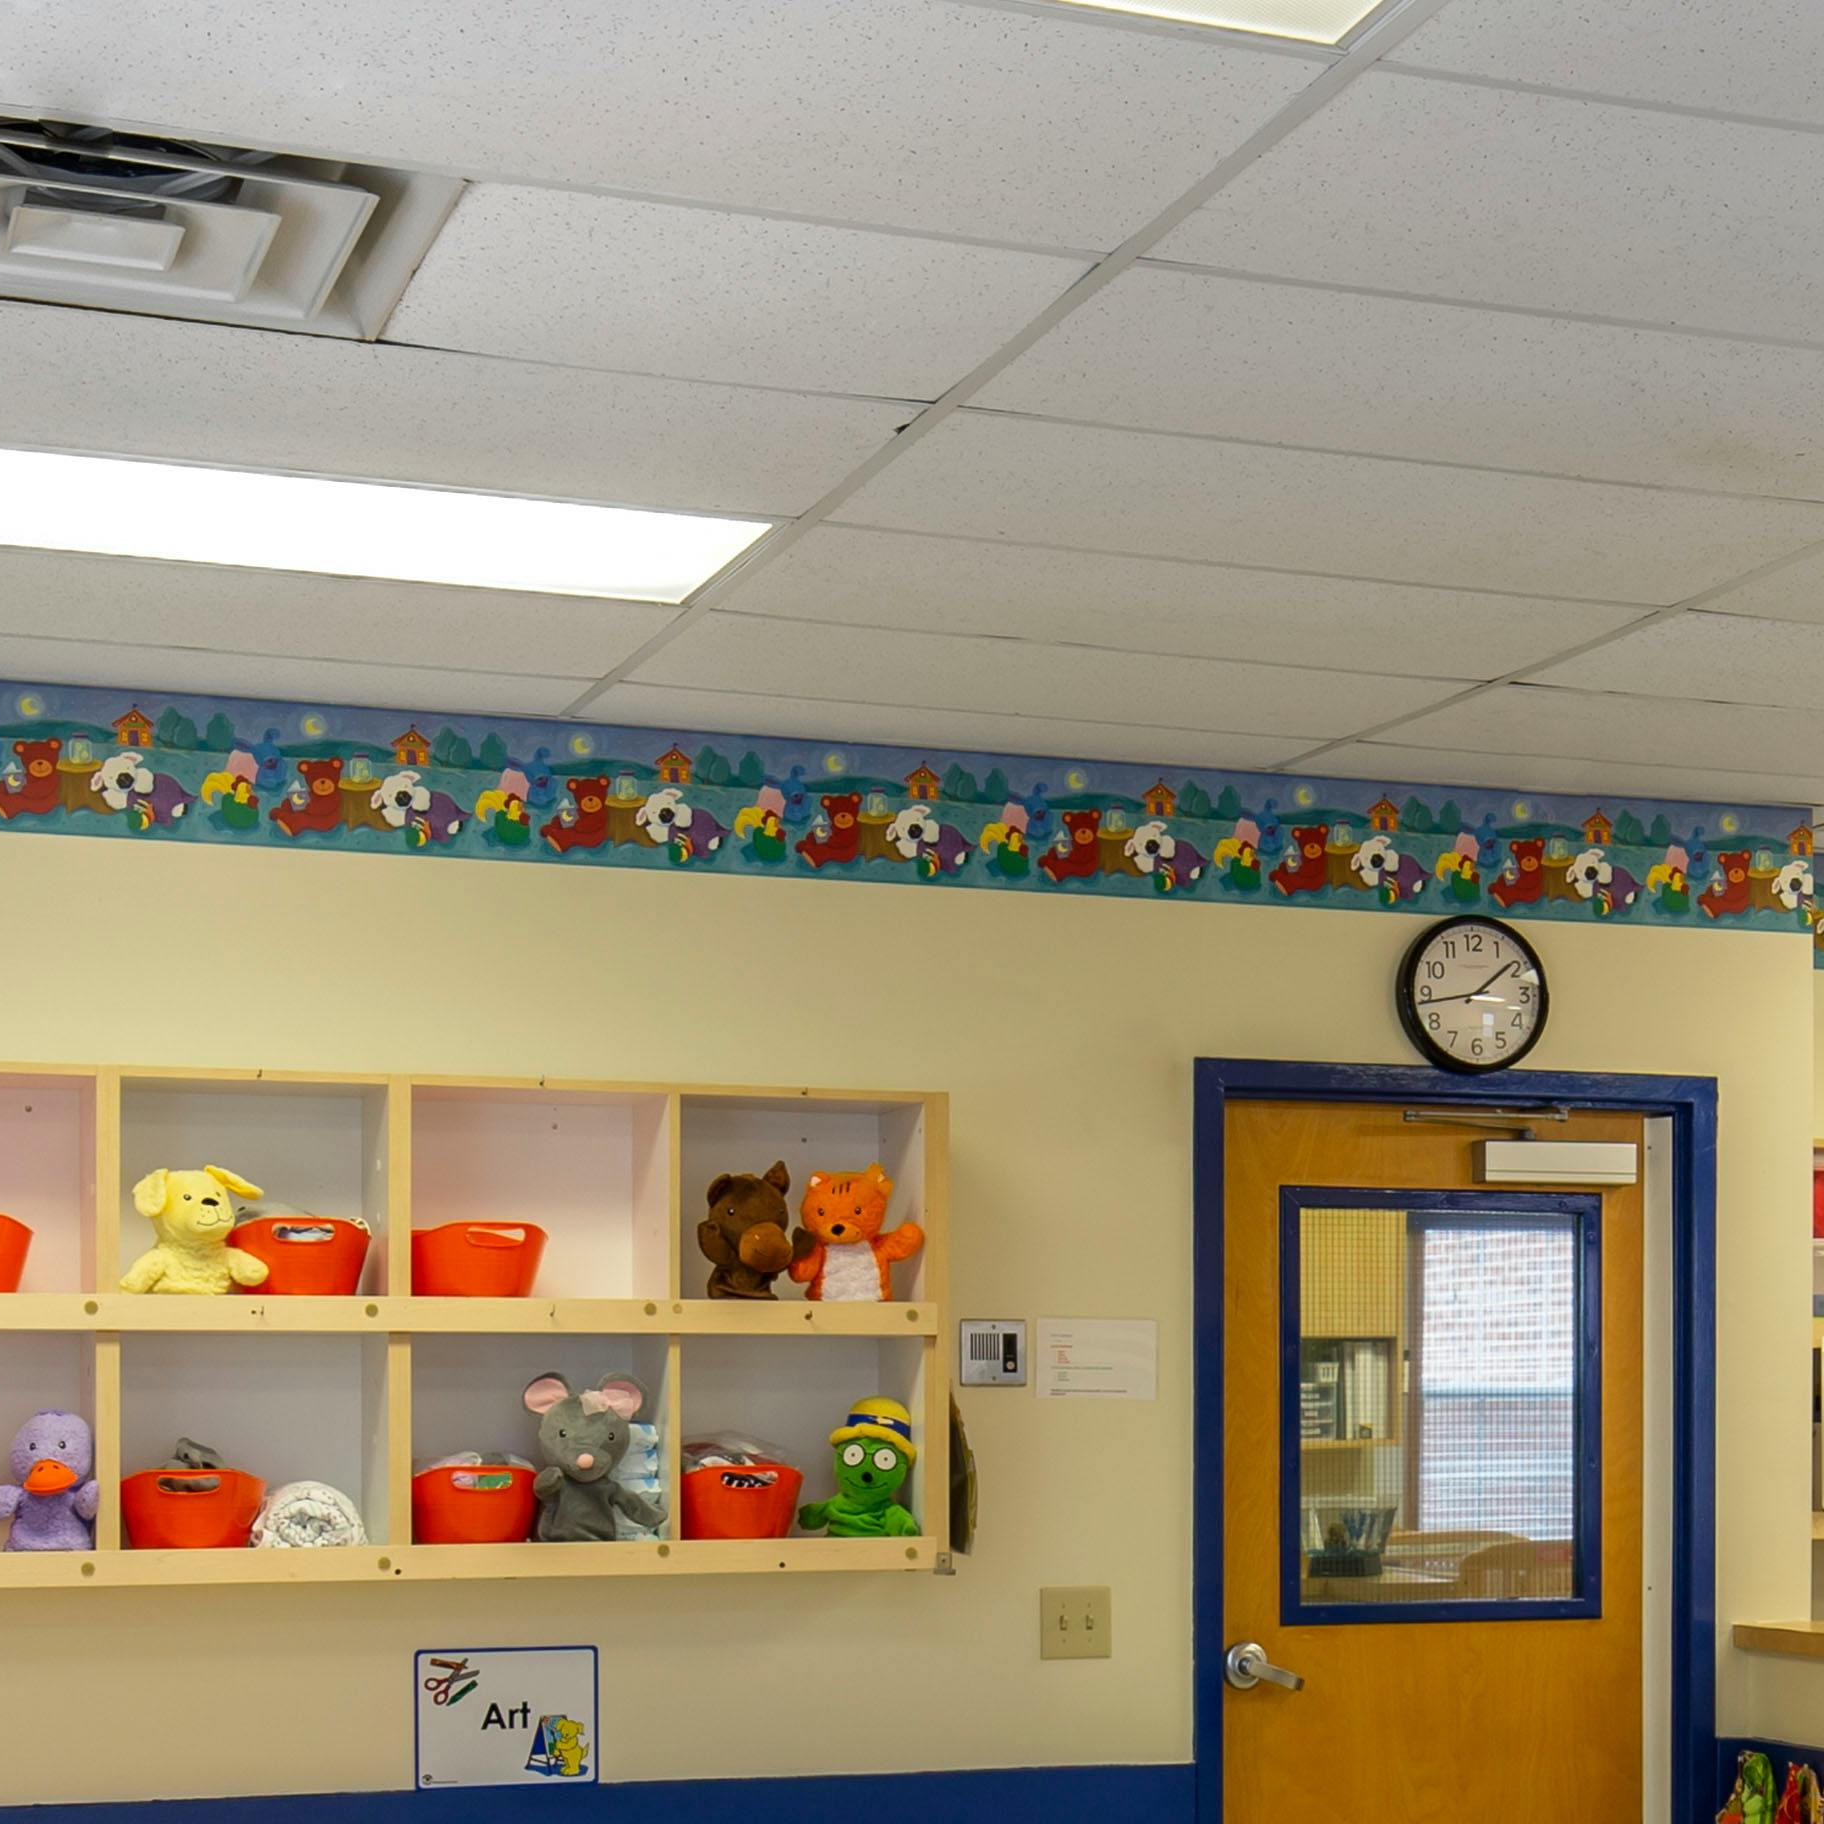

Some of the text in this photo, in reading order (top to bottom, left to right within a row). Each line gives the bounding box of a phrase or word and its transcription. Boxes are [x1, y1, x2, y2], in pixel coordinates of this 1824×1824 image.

[1442, 941, 1456, 959] 11
[1464, 934, 1483, 952] 12
[1493, 941, 1500, 958] 1
[1425, 961, 1445, 979] 10
[1510, 960, 1521, 978] 2
[1420, 985, 1432, 1001] 9
[1518, 986, 1530, 1004] 3
[1428, 1012, 1441, 1031] 8
[1510, 1013, 1523, 1030] 4
[1447, 1030, 1458, 1048] 7
[1471, 1038, 1483, 1056] 6
[1495, 1031, 1507, 1049] 5
[481, 1700, 531, 1731] Art
